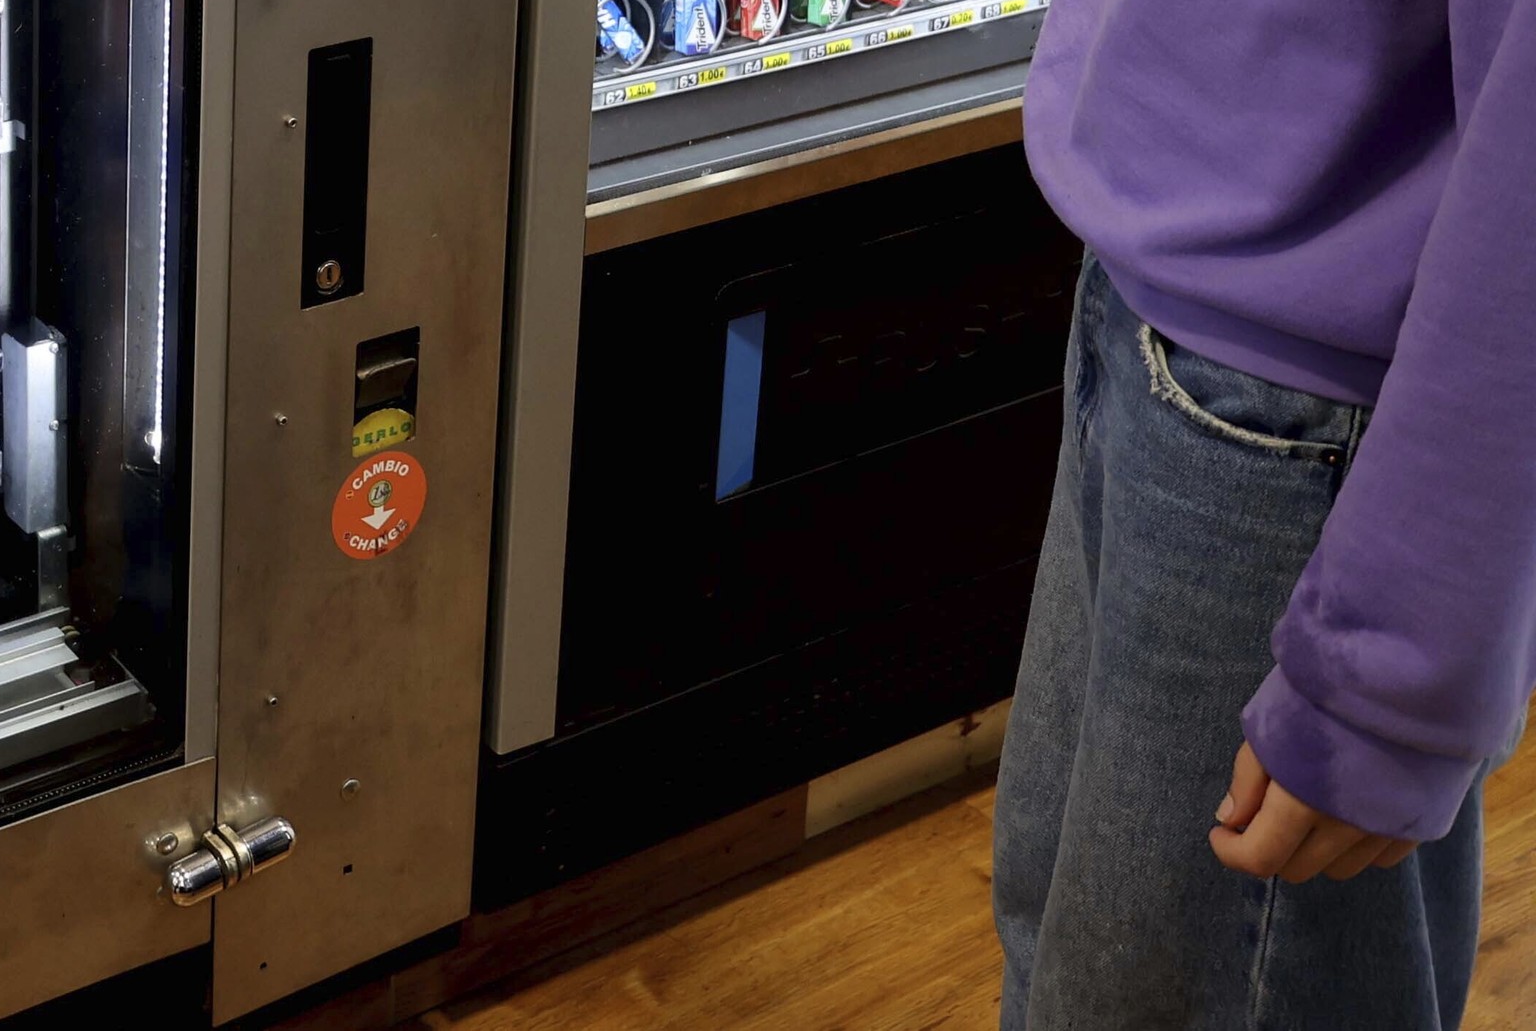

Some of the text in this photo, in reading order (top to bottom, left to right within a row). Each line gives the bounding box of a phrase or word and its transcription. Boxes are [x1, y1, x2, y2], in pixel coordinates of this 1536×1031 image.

[697, 7, 708, 51] Trident
[679, 75, 697, 88] 63
[352, 460, 410, 490] CAMBIO
[349, 518, 407, 552] CHANGE
